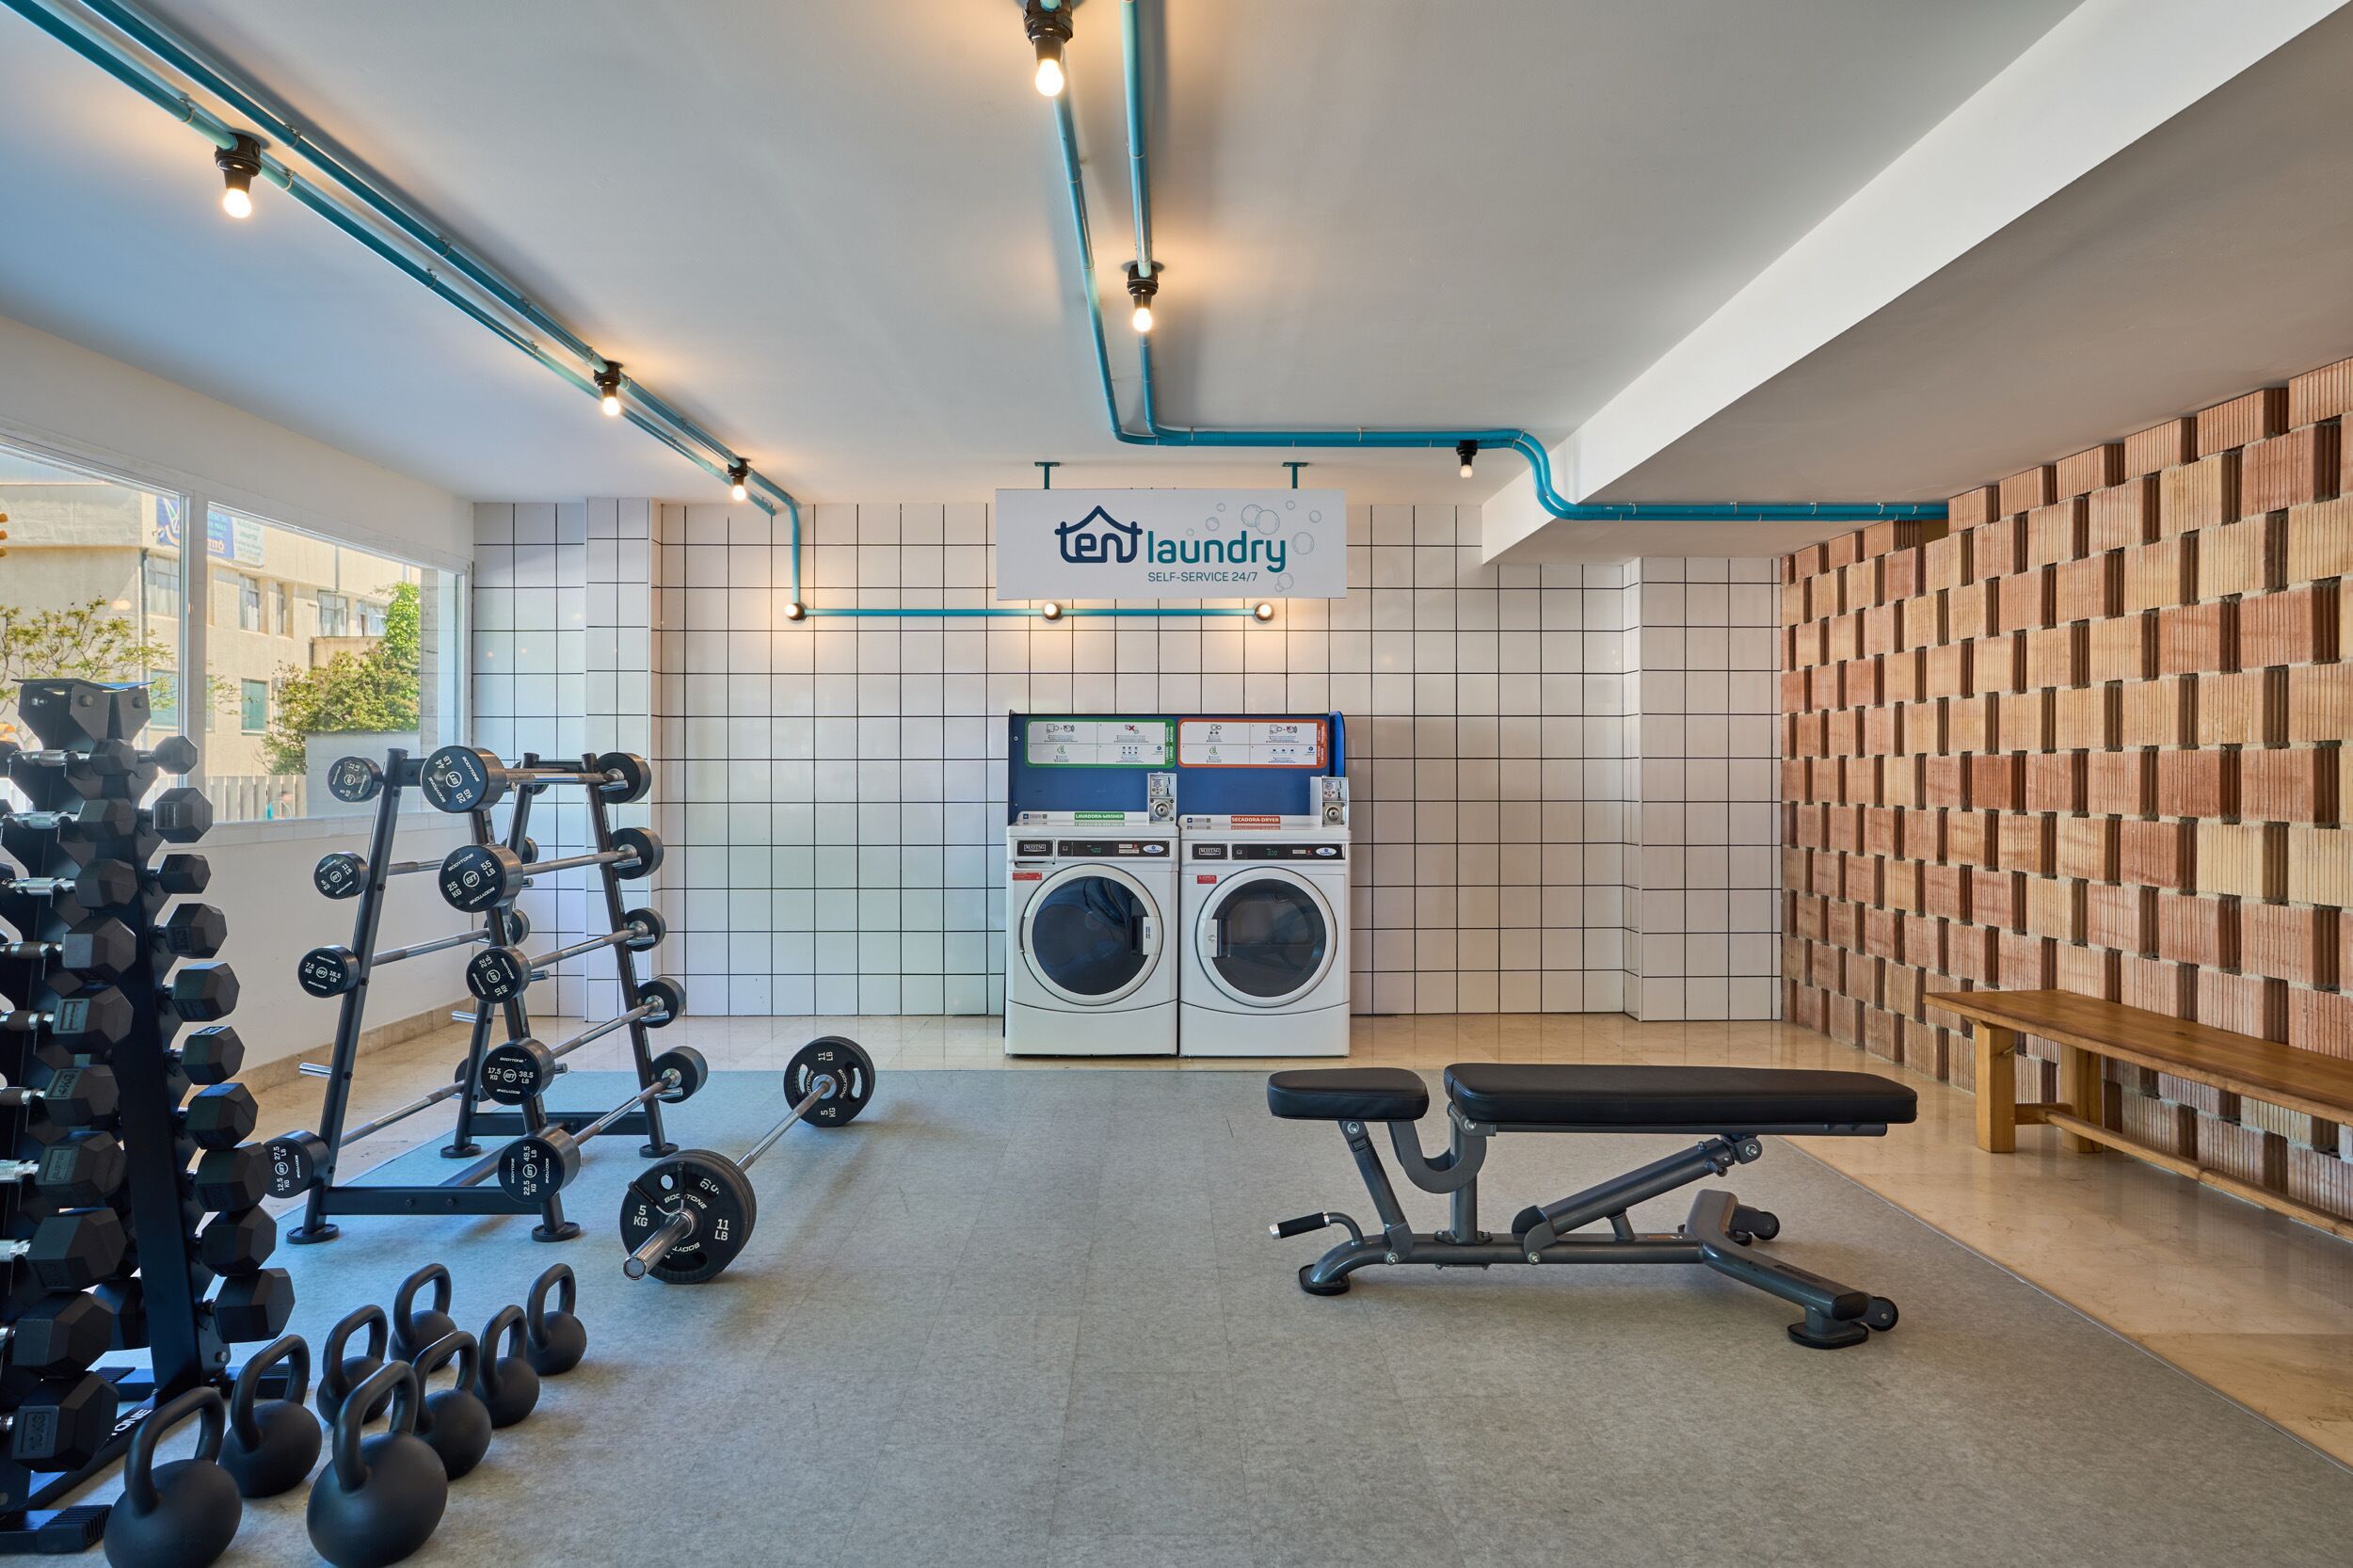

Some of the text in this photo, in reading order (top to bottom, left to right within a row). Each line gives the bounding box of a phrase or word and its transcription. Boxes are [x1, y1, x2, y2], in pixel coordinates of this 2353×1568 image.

[1147, 530, 1287, 573] laundry
[1147, 571, 1258, 583] SELF-SERVICE 24/7
[435, 759, 445, 769] 44
[442, 755, 453, 766] LB
[456, 792, 467, 804] 20
[463, 788, 473, 800] KG
[447, 853, 474, 872] BODYTONE
[480, 859, 492, 871] 55
[485, 867, 496, 877] LB
[446, 880, 458, 892] 25
[451, 888, 462, 899] KG
[478, 958, 488, 968] 22
[817, 1051, 826, 1062] 11
[825, 1051, 834, 1062] LB
[488, 1066, 502, 1075] 17.5
[519, 1070, 534, 1079] 38.5
[837, 1068, 848, 1099] BODYTONE
[828, 1107, 837, 1118] KG
[530, 1149, 537, 1159] LB
[530, 1183, 537, 1192] KG
[638, 1205, 648, 1216] 5
[632, 1215, 648, 1227] KG
[716, 1218, 729, 1231] 11
[714, 1229, 728, 1241] LB
